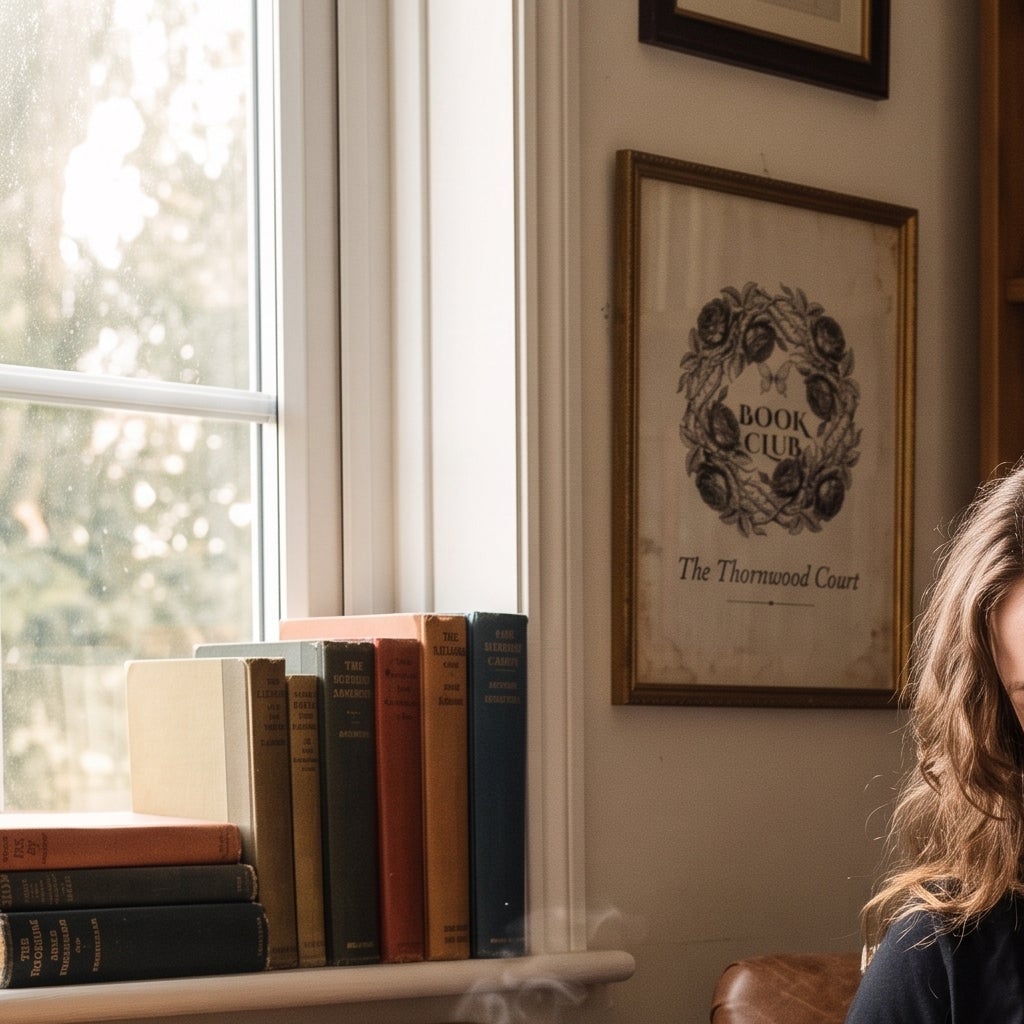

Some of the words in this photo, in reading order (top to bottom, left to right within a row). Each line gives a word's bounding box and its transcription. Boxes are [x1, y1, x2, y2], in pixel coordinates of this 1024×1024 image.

[739, 404, 812, 439] BOOK
[744, 432, 802, 461] CLUB
[678, 555, 711, 582] The
[717, 558, 812, 588] Thornwood
[815, 566, 860, 590] Court
